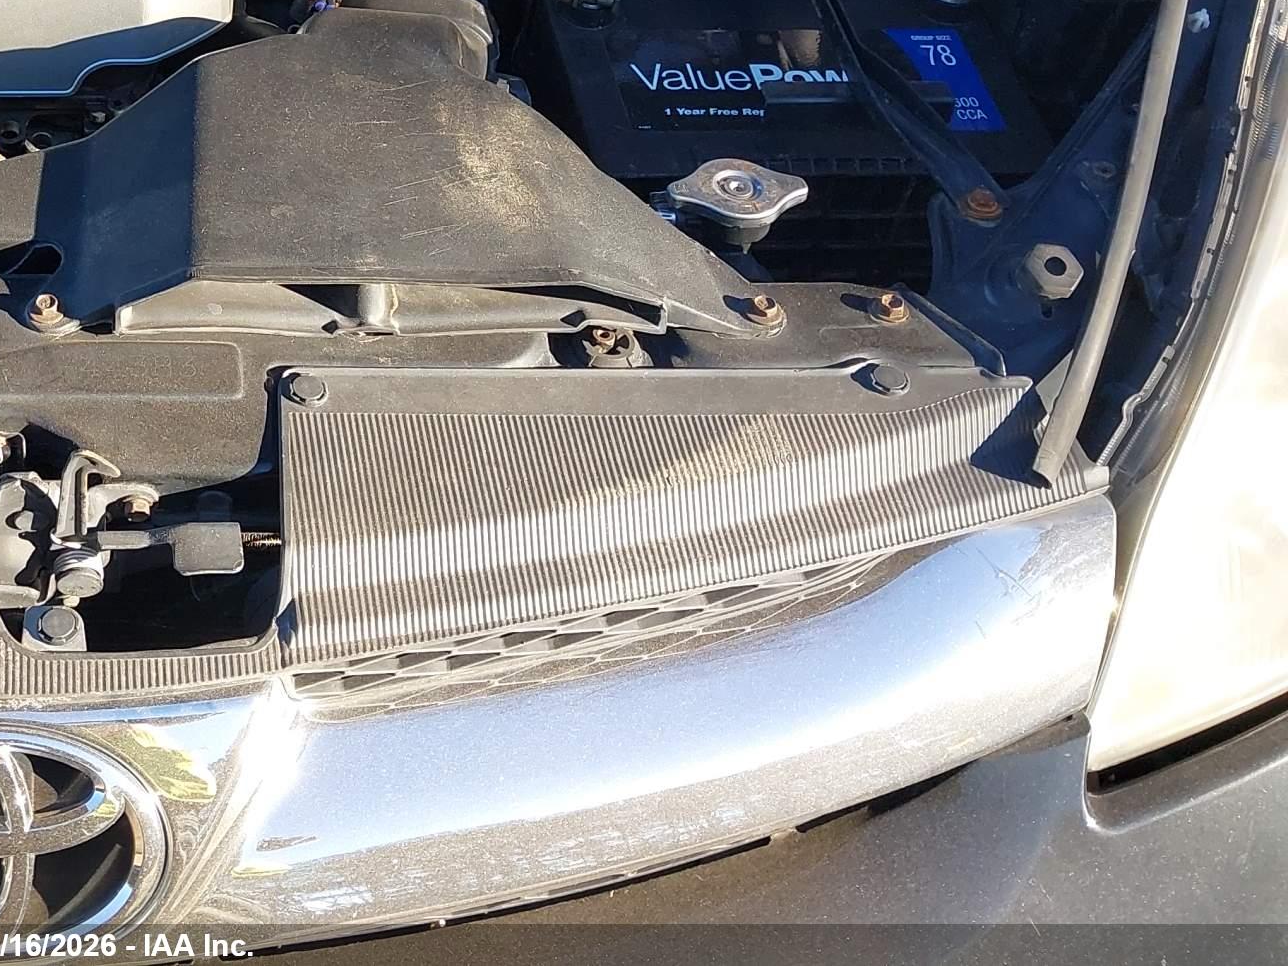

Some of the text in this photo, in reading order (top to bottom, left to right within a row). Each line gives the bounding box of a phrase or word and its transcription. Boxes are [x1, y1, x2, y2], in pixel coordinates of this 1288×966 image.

[919, 44, 956, 66] 78
[664, 107, 671, 116] 1
[676, 107, 706, 116] Year
[709, 107, 739, 116] Free
[956, 109, 988, 120] CCA
